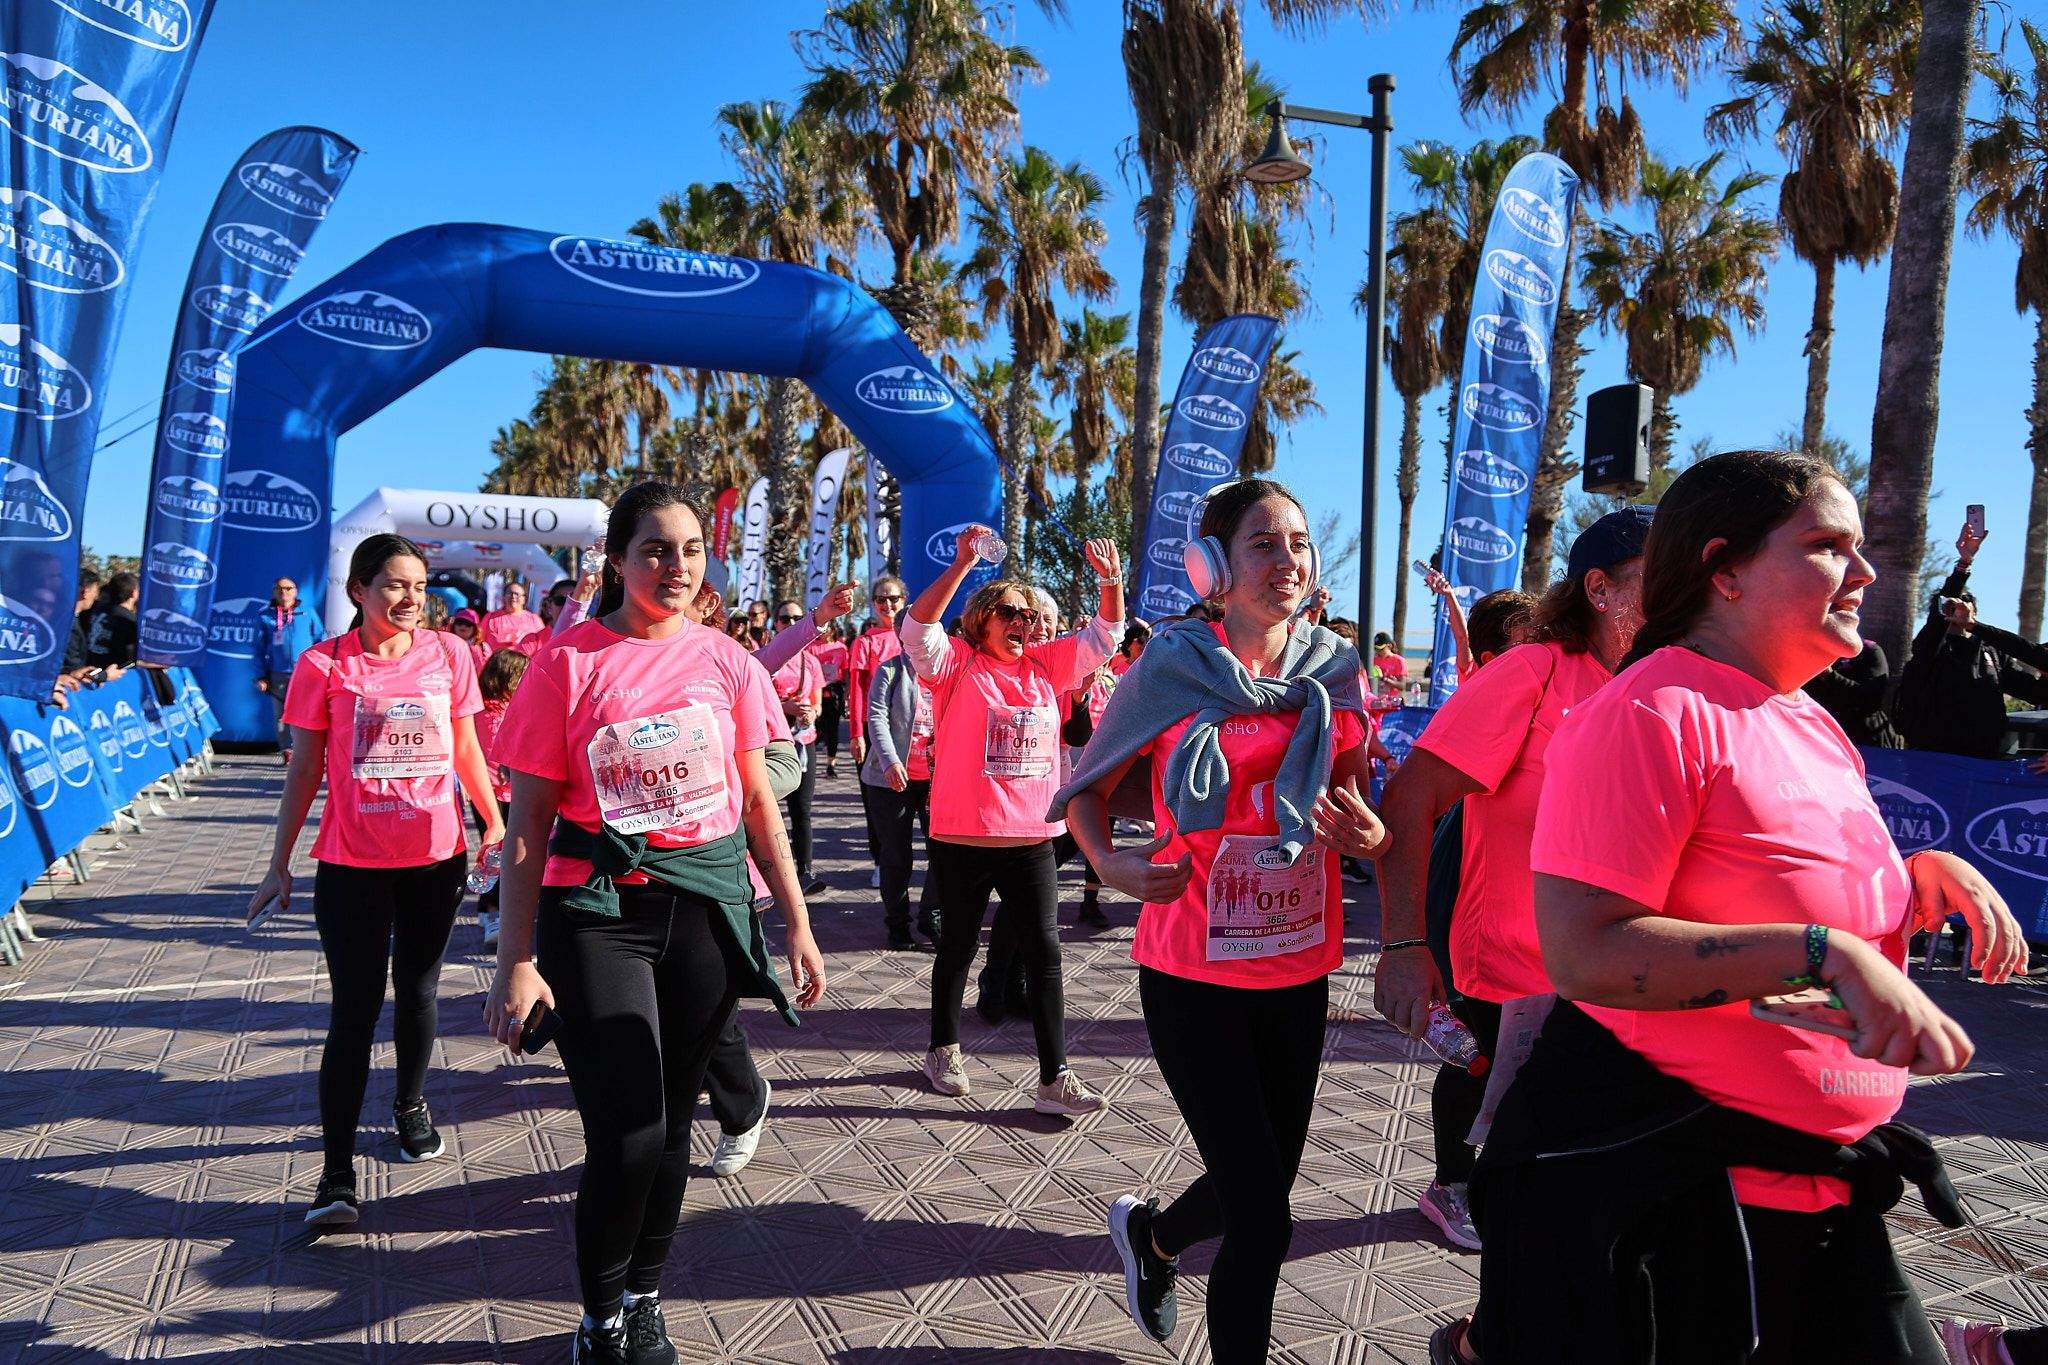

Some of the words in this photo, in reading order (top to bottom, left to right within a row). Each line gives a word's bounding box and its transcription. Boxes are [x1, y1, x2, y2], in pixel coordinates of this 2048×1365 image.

[0, 86, 135, 167] STURIANA
[566, 239, 746, 280] ASTURIANA
[306, 308, 420, 341] ASTURIANA
[864, 381, 949, 404] ASTURIANA
[1185, 401, 1240, 426] ASTURIANA
[1170, 449, 1226, 474] ASTURIANA
[222, 498, 314, 523] STURIANA
[427, 502, 558, 532] OYSHO
[388, 733, 424, 746] 016
[1225, 722, 1260, 736] SHO
[1013, 738, 1038, 748] 016
[641, 761, 689, 787] 016
[655, 786, 678, 799] 6105
[619, 806, 647, 816] CARRERA
[621, 814, 660, 830] OYSHO
[684, 800, 716, 816] Santander
[1256, 887, 1301, 911] 016
[1265, 913, 1288, 925] 3662
[1273, 925, 1291, 933] MUJER
[1221, 942, 1264, 952] OYSHO
[1287, 932, 1315, 947] Santander
